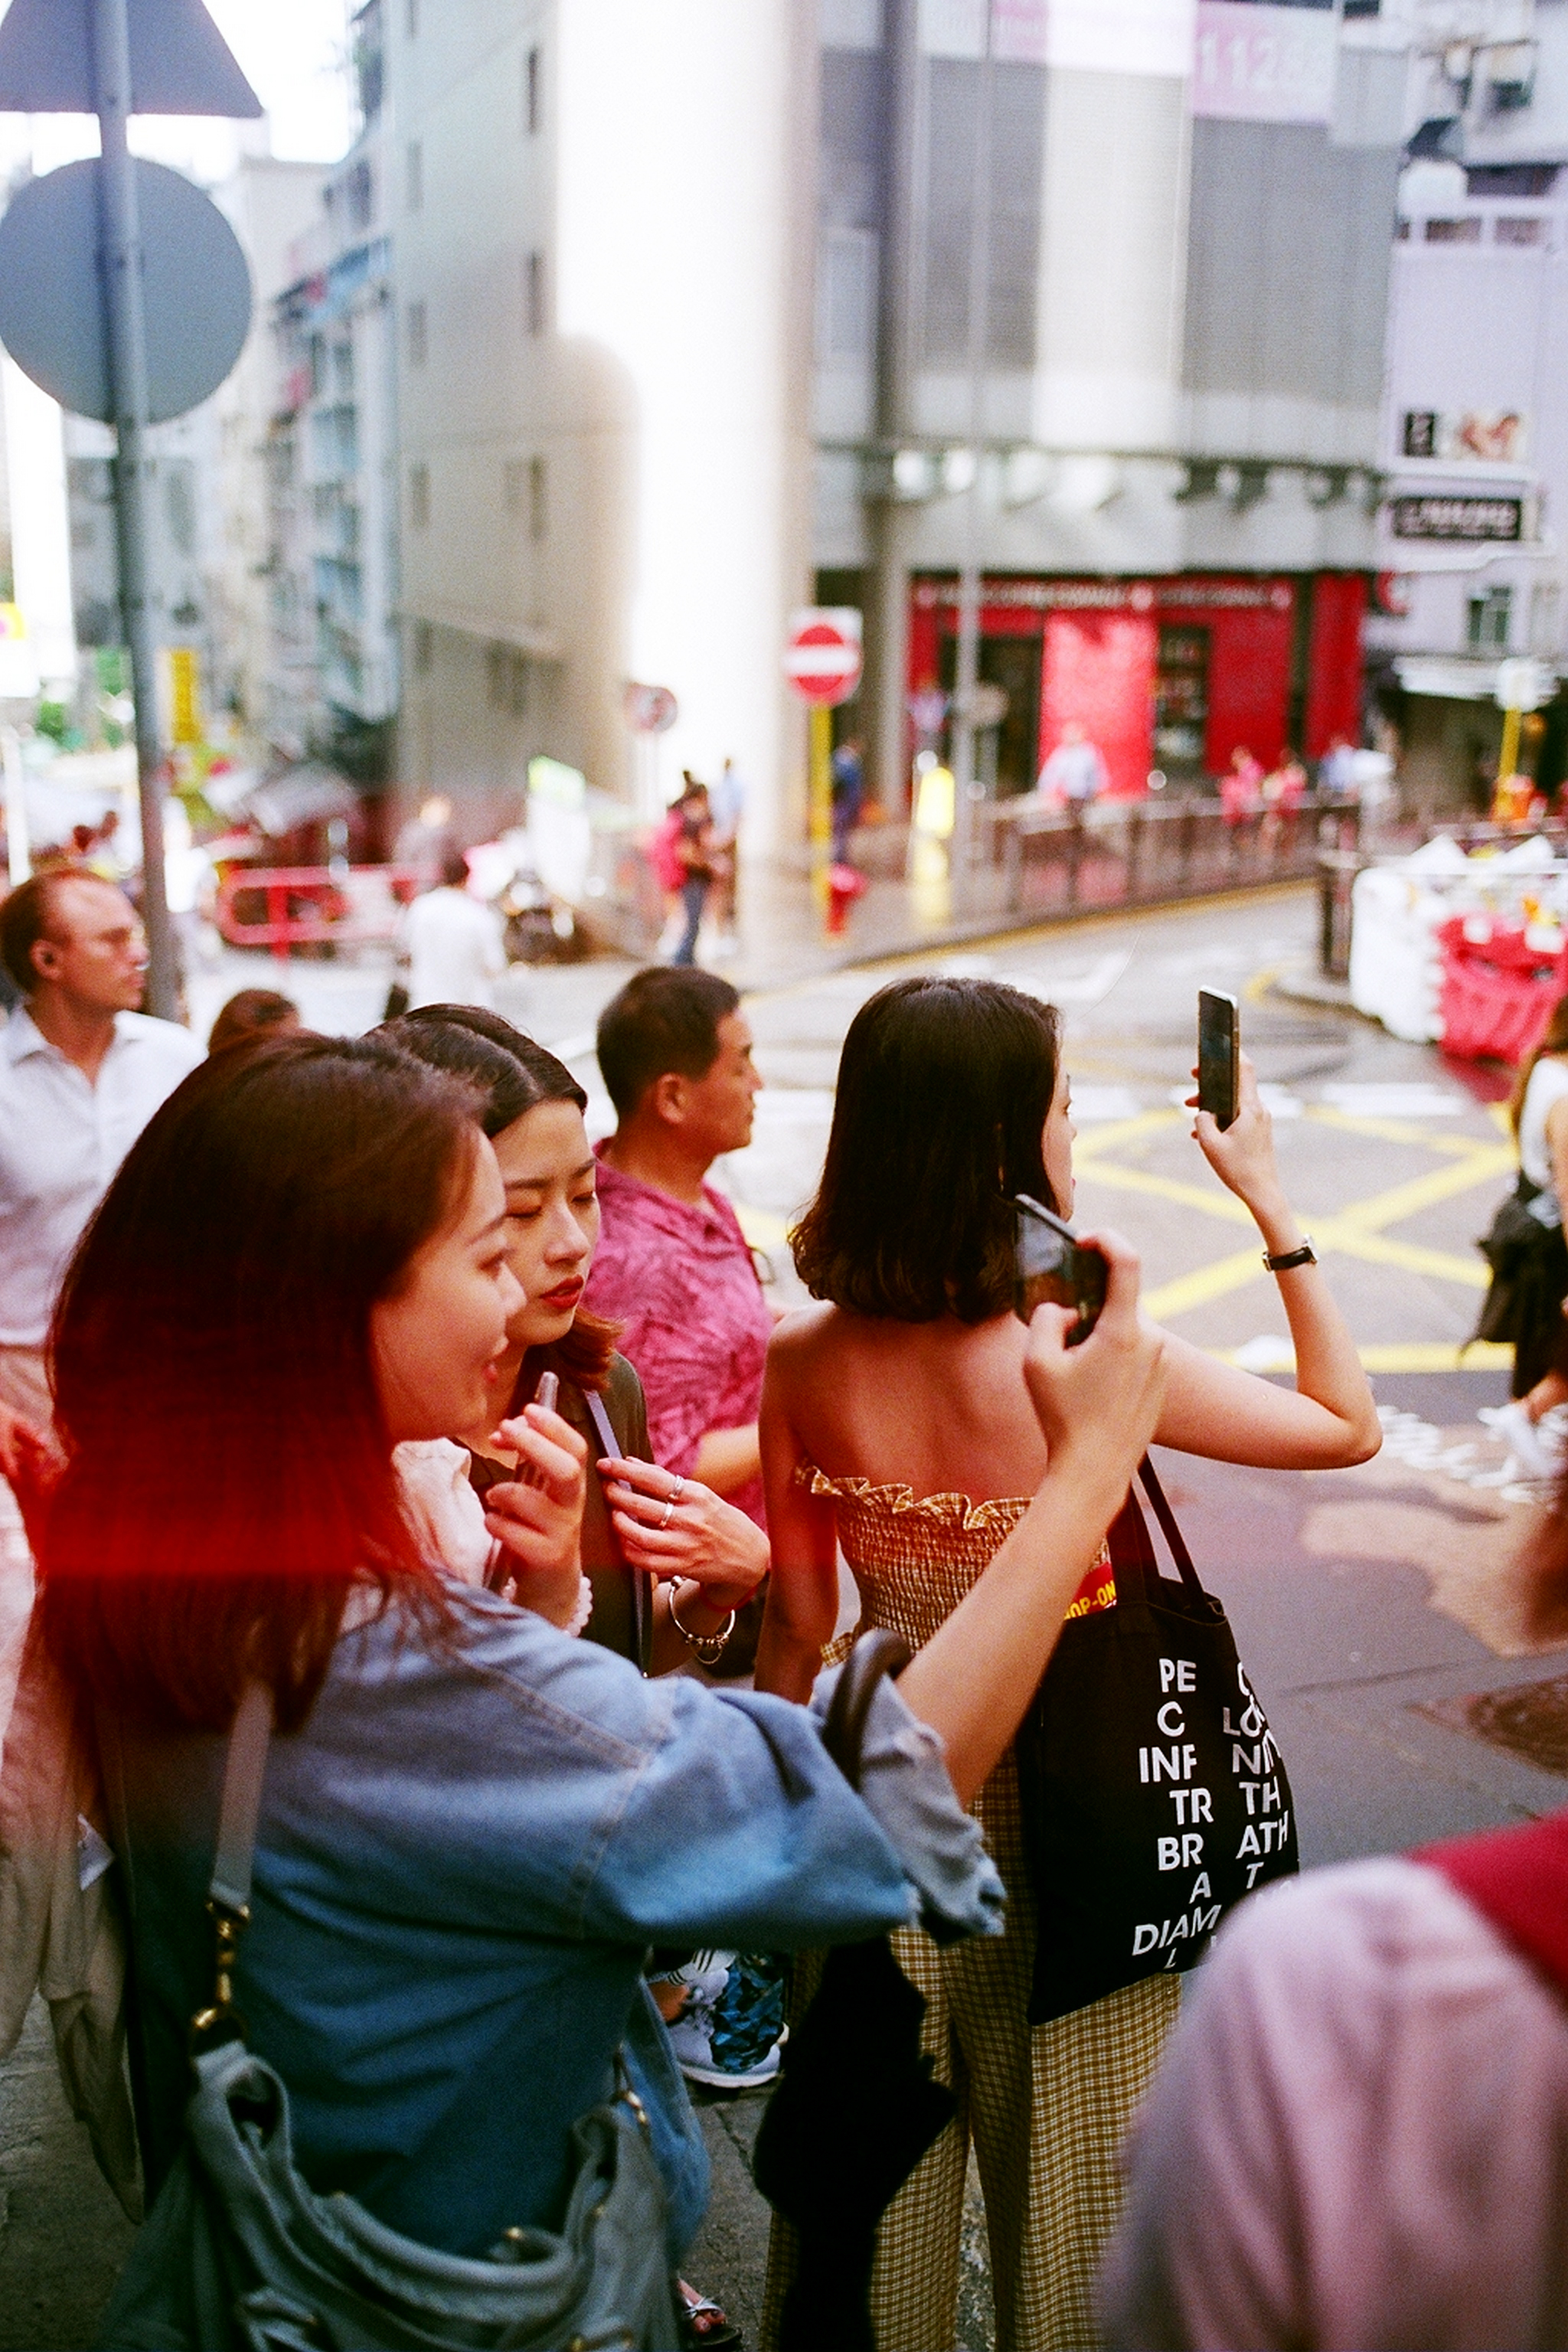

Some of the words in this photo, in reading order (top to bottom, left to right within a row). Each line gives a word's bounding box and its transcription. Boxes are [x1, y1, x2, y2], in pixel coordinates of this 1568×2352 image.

[1158, 1658, 1197, 1693] PE
[1157, 1701, 1185, 1737] C
[1138, 1744, 1197, 1783] INF
[1169, 1788, 1214, 1825] TR
[1239, 1775, 1281, 1815] TH
[1157, 1833, 1204, 1870] BR
[1235, 1810, 1289, 1859] ATH
[1188, 1871, 1211, 1904] A
[1132, 1904, 1222, 1956] DIAM
